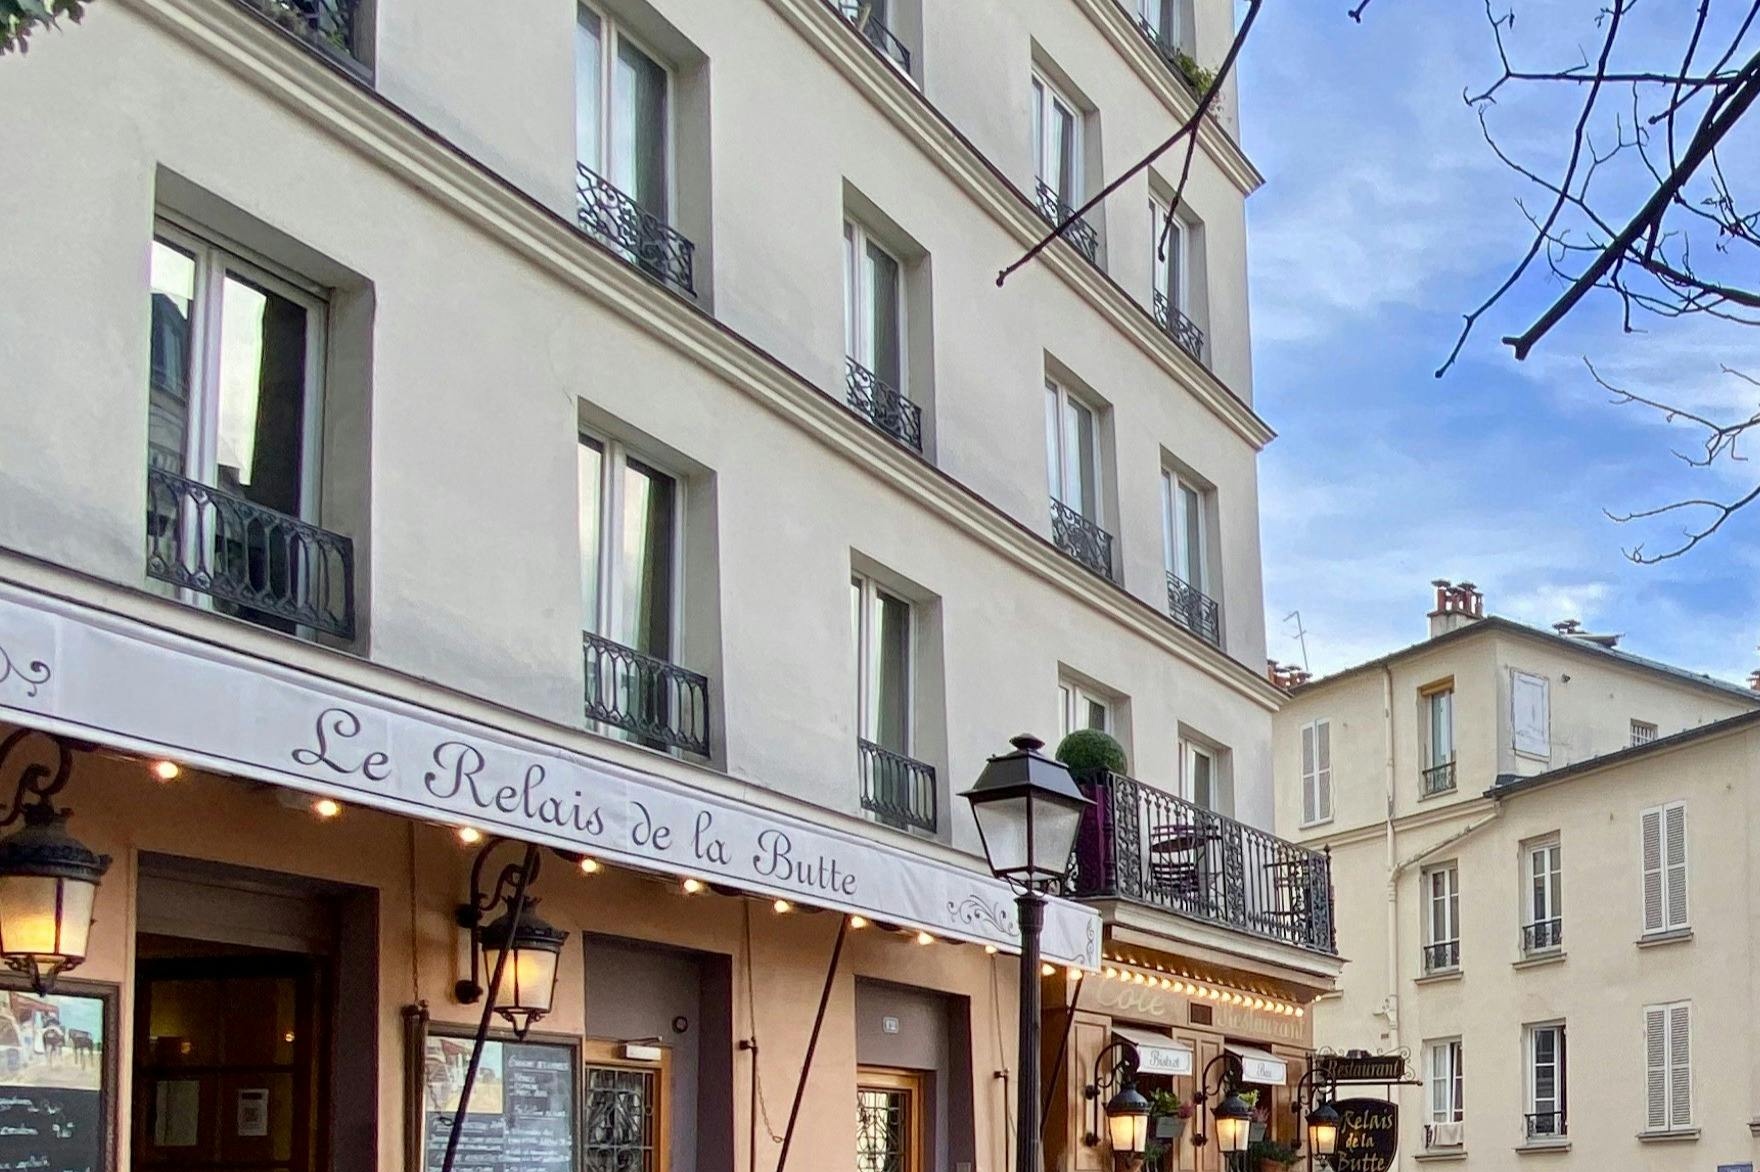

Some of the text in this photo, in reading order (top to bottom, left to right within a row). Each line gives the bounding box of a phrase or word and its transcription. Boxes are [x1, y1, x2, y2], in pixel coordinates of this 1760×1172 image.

[291, 708, 858, 896] Le Relais de la Butte
[1327, 1058, 1399, 1078] Restaurant
[1340, 1109, 1393, 1134] Relais
[1345, 1131, 1375, 1149] de la
[1337, 1150, 1385, 1172] Butte
